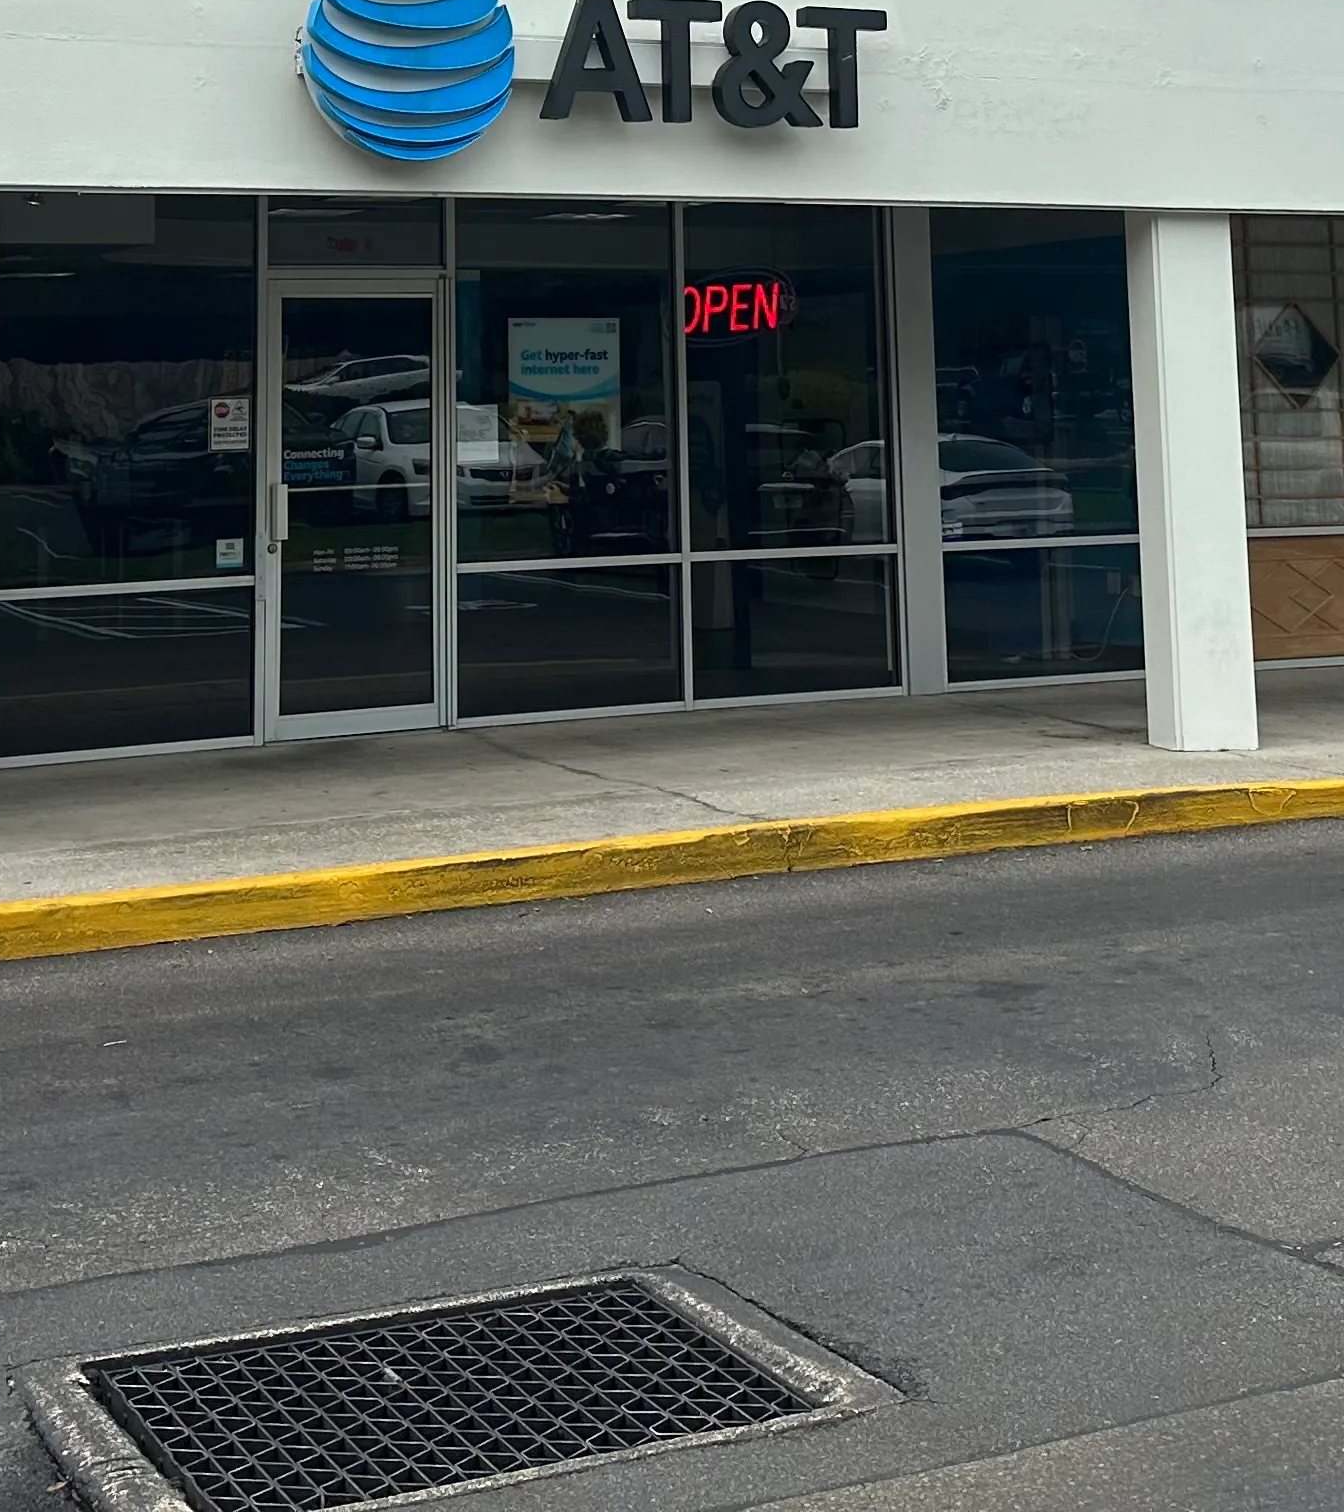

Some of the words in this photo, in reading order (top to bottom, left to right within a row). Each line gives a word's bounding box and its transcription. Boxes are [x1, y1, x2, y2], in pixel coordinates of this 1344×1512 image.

[683, 280, 782, 337] OPEN
[520, 349, 543, 361] Get
[545, 348, 609, 364] hyper-fast
[521, 363, 570, 375] internet
[573, 363, 600, 375] here
[284, 447, 345, 460] Connecting
[284, 460, 329, 472] Changes
[284, 469, 343, 483] Everything
